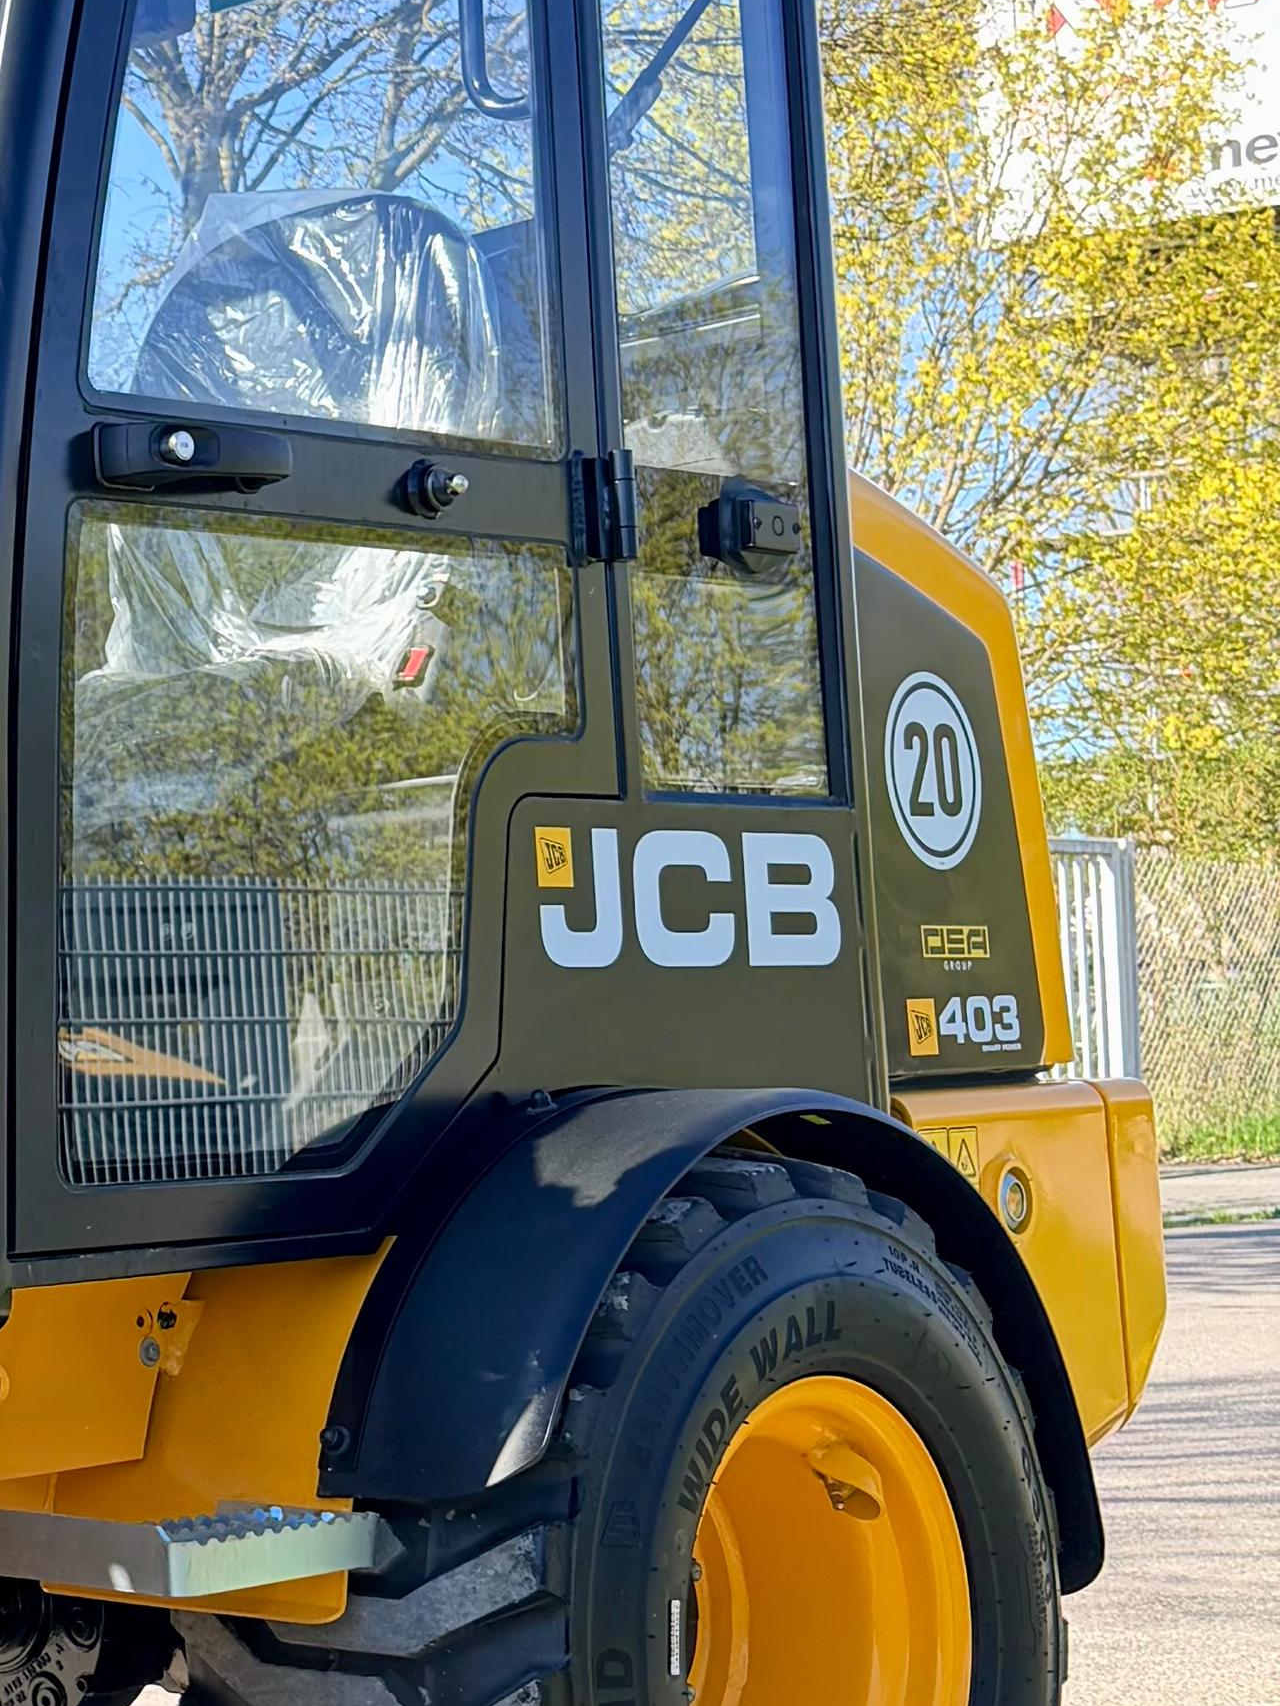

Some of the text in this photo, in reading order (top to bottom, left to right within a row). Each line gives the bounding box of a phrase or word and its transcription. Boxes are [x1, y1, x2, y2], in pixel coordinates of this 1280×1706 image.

[1210, 134, 1280, 171] ne
[903, 721, 963, 817] 20
[542, 839, 567, 872] JCB
[540, 828, 841, 969] JCB
[943, 960, 973, 972] GROUP
[939, 994, 1021, 1044] 403
[677, 1299, 842, 1514] WIDE WALL
